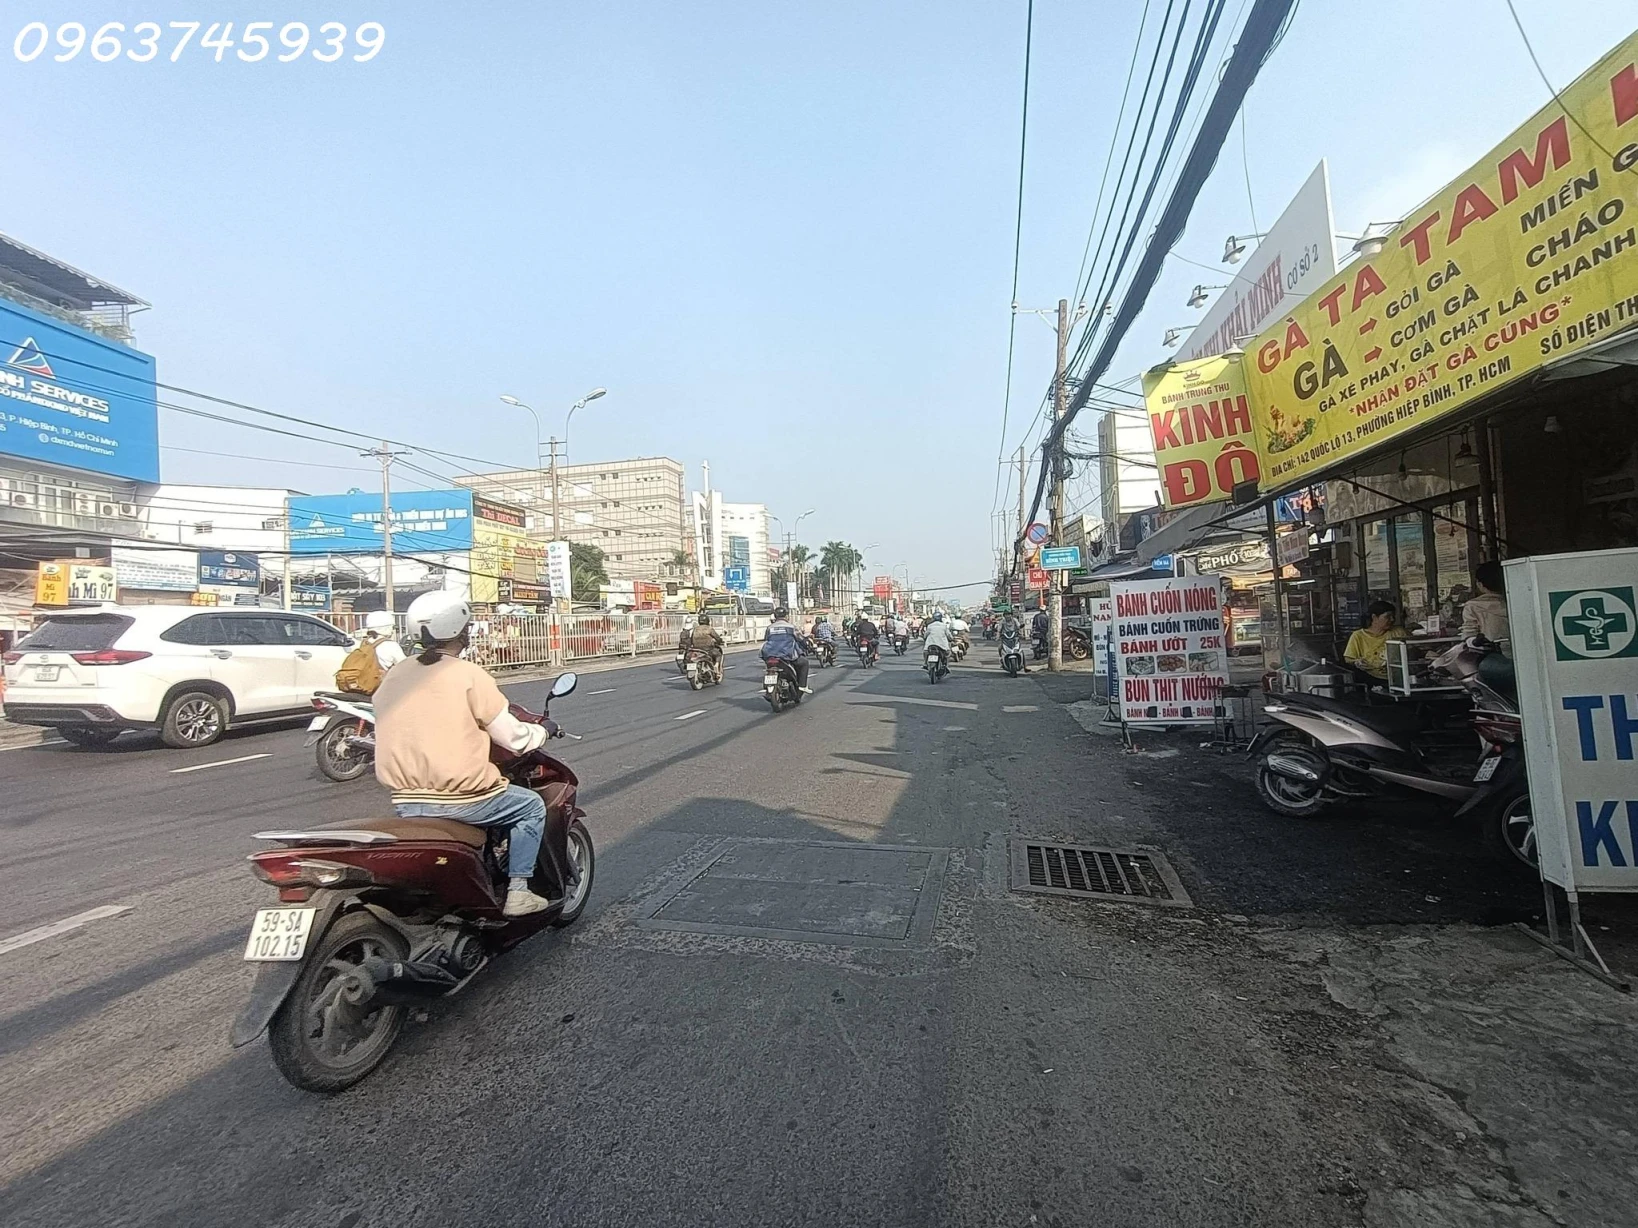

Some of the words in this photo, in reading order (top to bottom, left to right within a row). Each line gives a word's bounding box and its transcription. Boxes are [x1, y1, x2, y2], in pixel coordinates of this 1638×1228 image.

[1520, 168, 1599, 233] MIẾN
[1258, 316, 1310, 374] GÀ
[1318, 264, 1387, 327] TA
[1400, 115, 1571, 266] TAM
[1526, 199, 1624, 267] CHÁO
[1287, 262, 1299, 290] CƠ
[1312, 244, 1319, 263] 2
[1385, 286, 1420, 319] GỎI
[1427, 260, 1462, 292] GÀ
[1248, 254, 1284, 330] MINH
[1319, 394, 1337, 413] GÀ
[1339, 382, 1357, 402] XÉ
[1360, 359, 1406, 391] PHAY,
[1410, 339, 1435, 363] GÀ
[1439, 307, 1490, 347] CHẶT
[1498, 286, 1529, 316] LÁ
[1535, 227, 1636, 295] CHANH
[1390, 310, 1437, 348] CƠM
[1444, 284, 1480, 317] GÀ
[1540, 325, 1563, 355] SỐ
[1566, 309, 1611, 345] ĐIỆN
[1294, 338, 1349, 400] GÀ
[1404, 362, 1439, 393] ĐẶT
[1446, 344, 1478, 371] GÀ
[30, 381, 109, 412] SERVICES
[1161, 390, 1185, 405] BÁNH
[1186, 386, 1213, 399] TRUNG
[1215, 382, 1230, 393] THU
[1297, 453, 1310, 466] 142
[1310, 441, 1330, 461] QUỐC
[1331, 438, 1341, 451] LỘ
[1342, 431, 1356, 445] 13,
[1356, 411, 1395, 439] PHƯỜNG
[1395, 398, 1420, 421] HIỆP
[1423, 383, 1456, 408] BÌNH,
[1457, 373, 1477, 392] TP.
[1479, 355, 1511, 384] HCM
[1150, 394, 1253, 451] KINH
[1163, 440, 1261, 506] ĐÔ
[43, 592, 56, 602] 97
[100, 582, 114, 600] 97
[1116, 588, 1148, 618] BÁNH
[1150, 582, 1181, 615] CUỐN
[1184, 583, 1218, 613] NÓNG
[1119, 618, 1149, 637] BÁNH
[1151, 617, 1181, 635] CUỐN
[1183, 616, 1220, 633] TRỨNG
[1120, 638, 1158, 655] BÁNH
[1162, 636, 1188, 652] ƯỚT
[1200, 636, 1222, 650] 25K
[1125, 674, 1150, 703] BÚN
[1152, 678, 1179, 707] THỊT
[1126, 706, 1142, 718] BÁNH
[1162, 706, 1179, 718] BÁNH
[1196, 705, 1213, 717] BÁNH
[254, 935, 304, 957] 102.15
